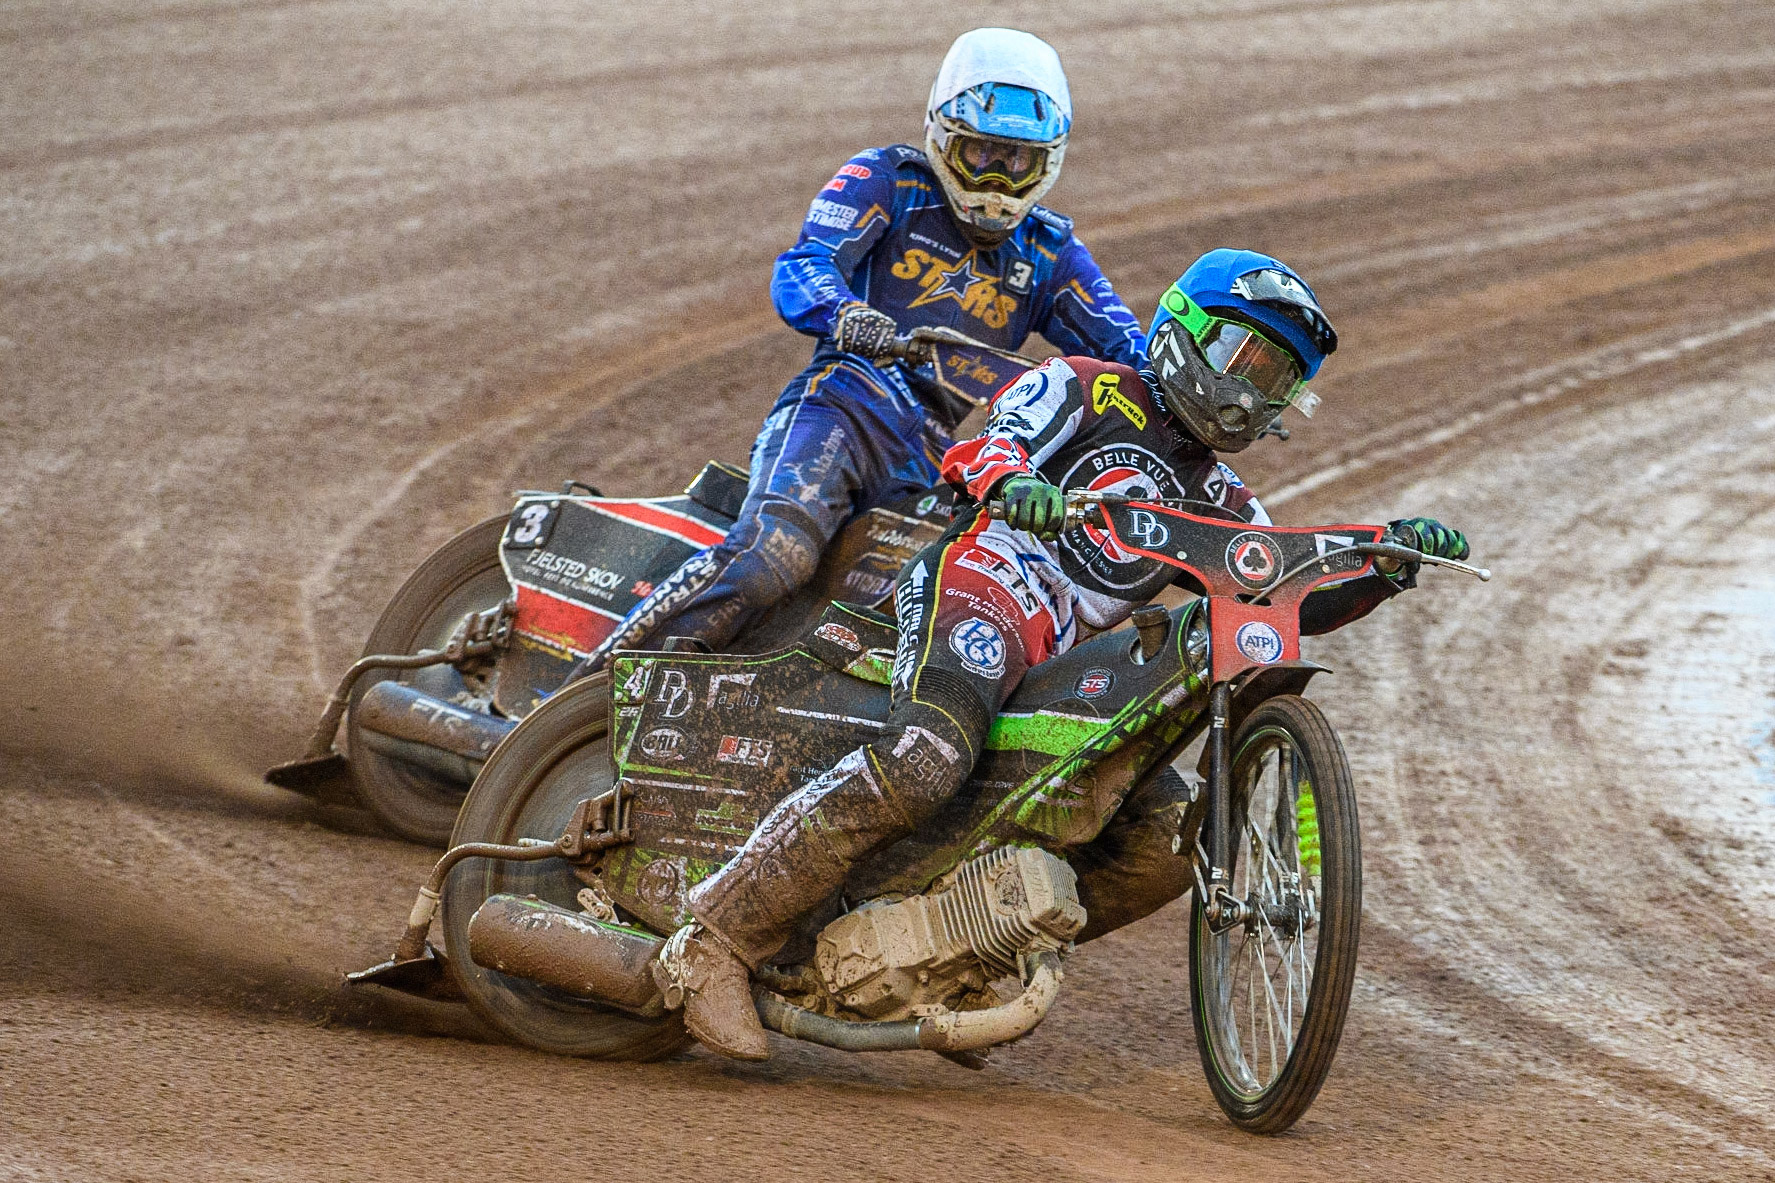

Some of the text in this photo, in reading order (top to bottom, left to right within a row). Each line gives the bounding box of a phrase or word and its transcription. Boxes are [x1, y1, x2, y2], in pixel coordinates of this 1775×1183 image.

[891, 249, 1018, 329] STARS
[1008, 261, 1033, 289] 3
[1092, 452, 1170, 492] BELLE VUE
[514, 504, 549, 543] 3
[525, 549, 588, 581] FJELSTED
[587, 569, 626, 591] SKOV
[993, 561, 1040, 613] FTS
[945, 587, 981, 605] Grant
[967, 601, 1009, 633] Tankers
[1244, 634, 1276, 651] ATPI
[1080, 678, 1108, 689] STS
